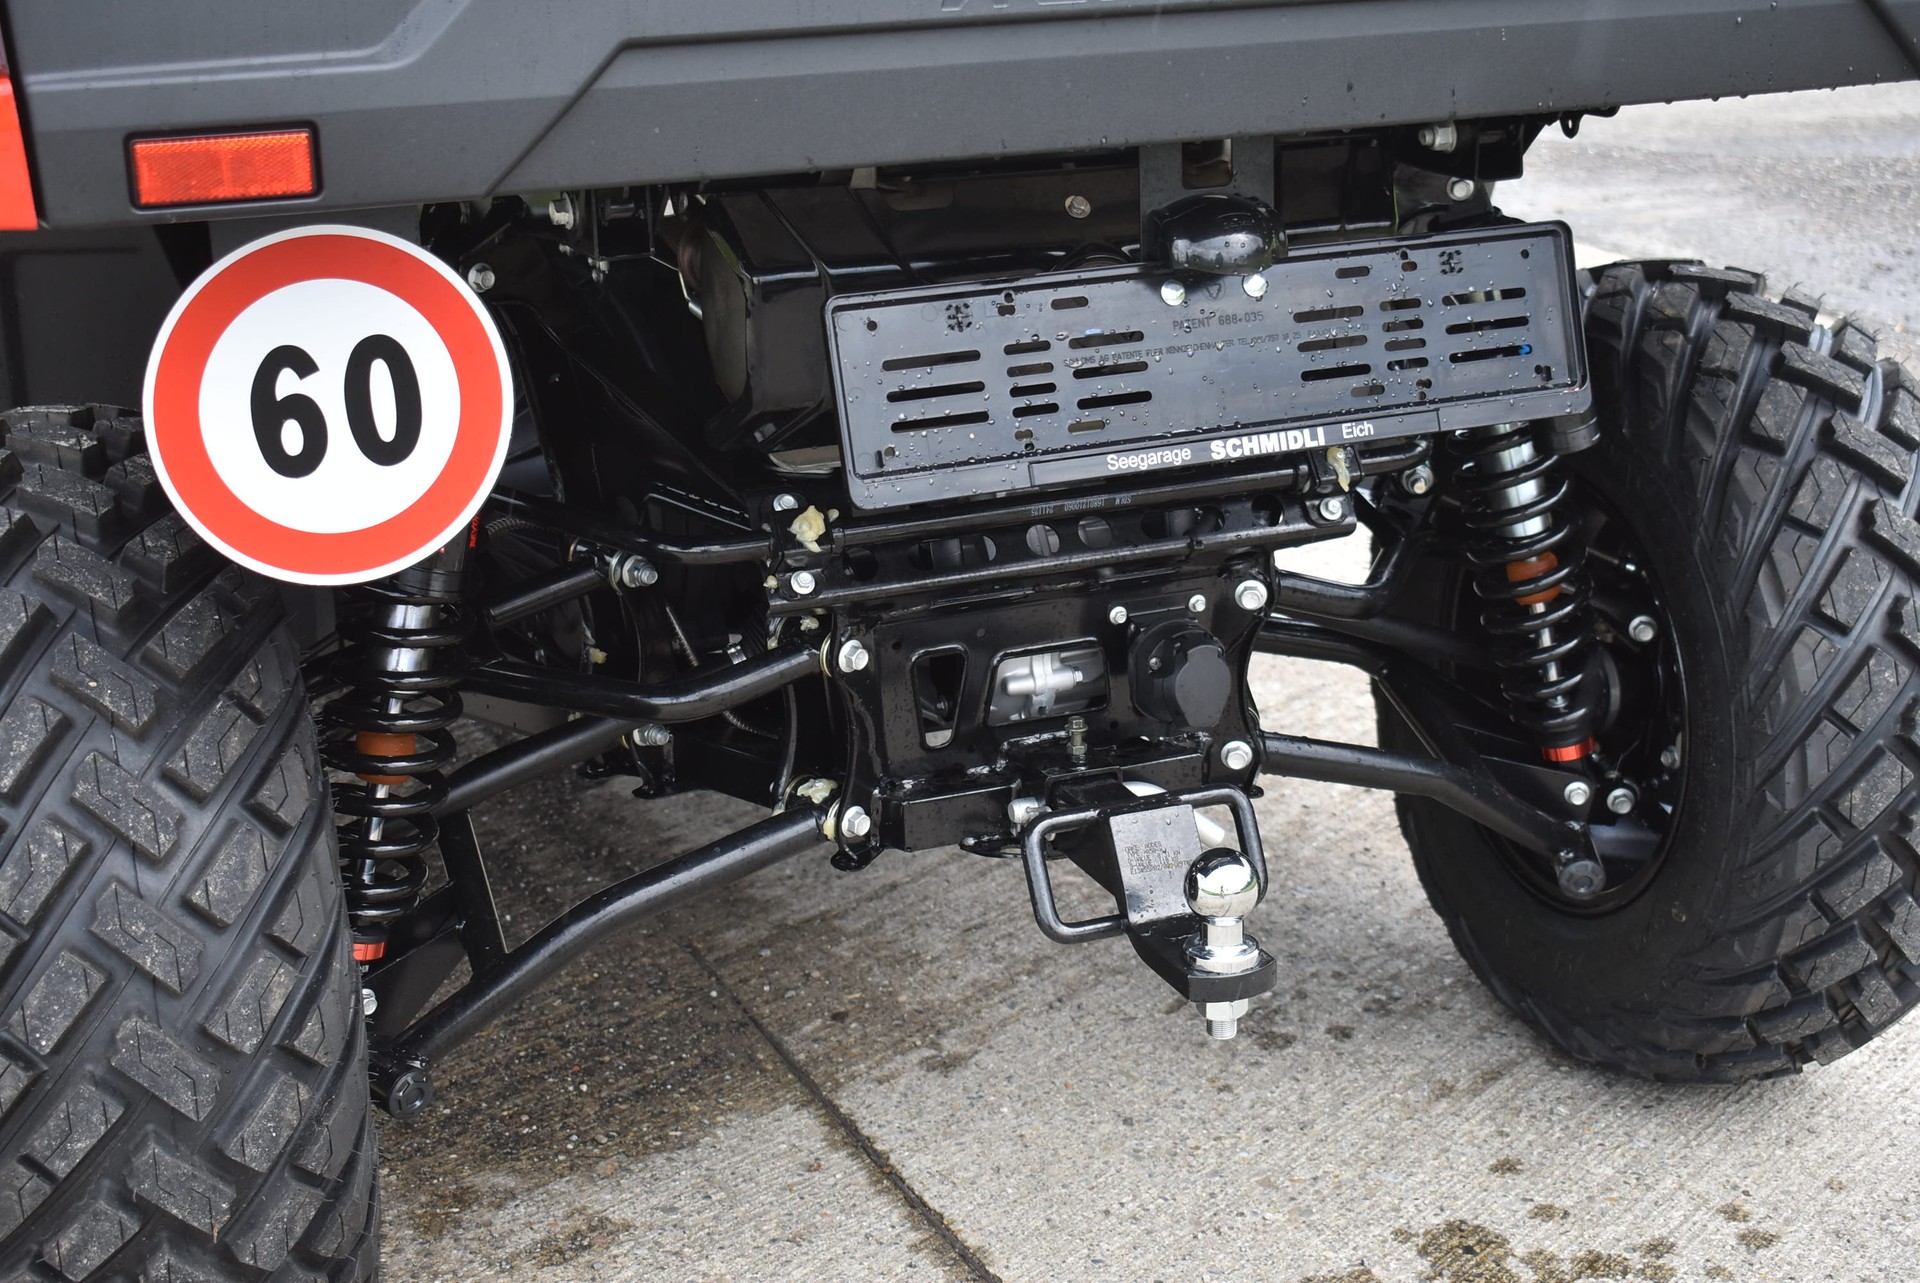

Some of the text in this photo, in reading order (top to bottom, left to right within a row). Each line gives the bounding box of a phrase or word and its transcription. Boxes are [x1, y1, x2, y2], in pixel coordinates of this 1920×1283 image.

[1172, 317, 1211, 331] PATENT
[250, 334, 423, 479] 60
[1106, 421, 1374, 472] Seegarage SCHMIDLI Eich
